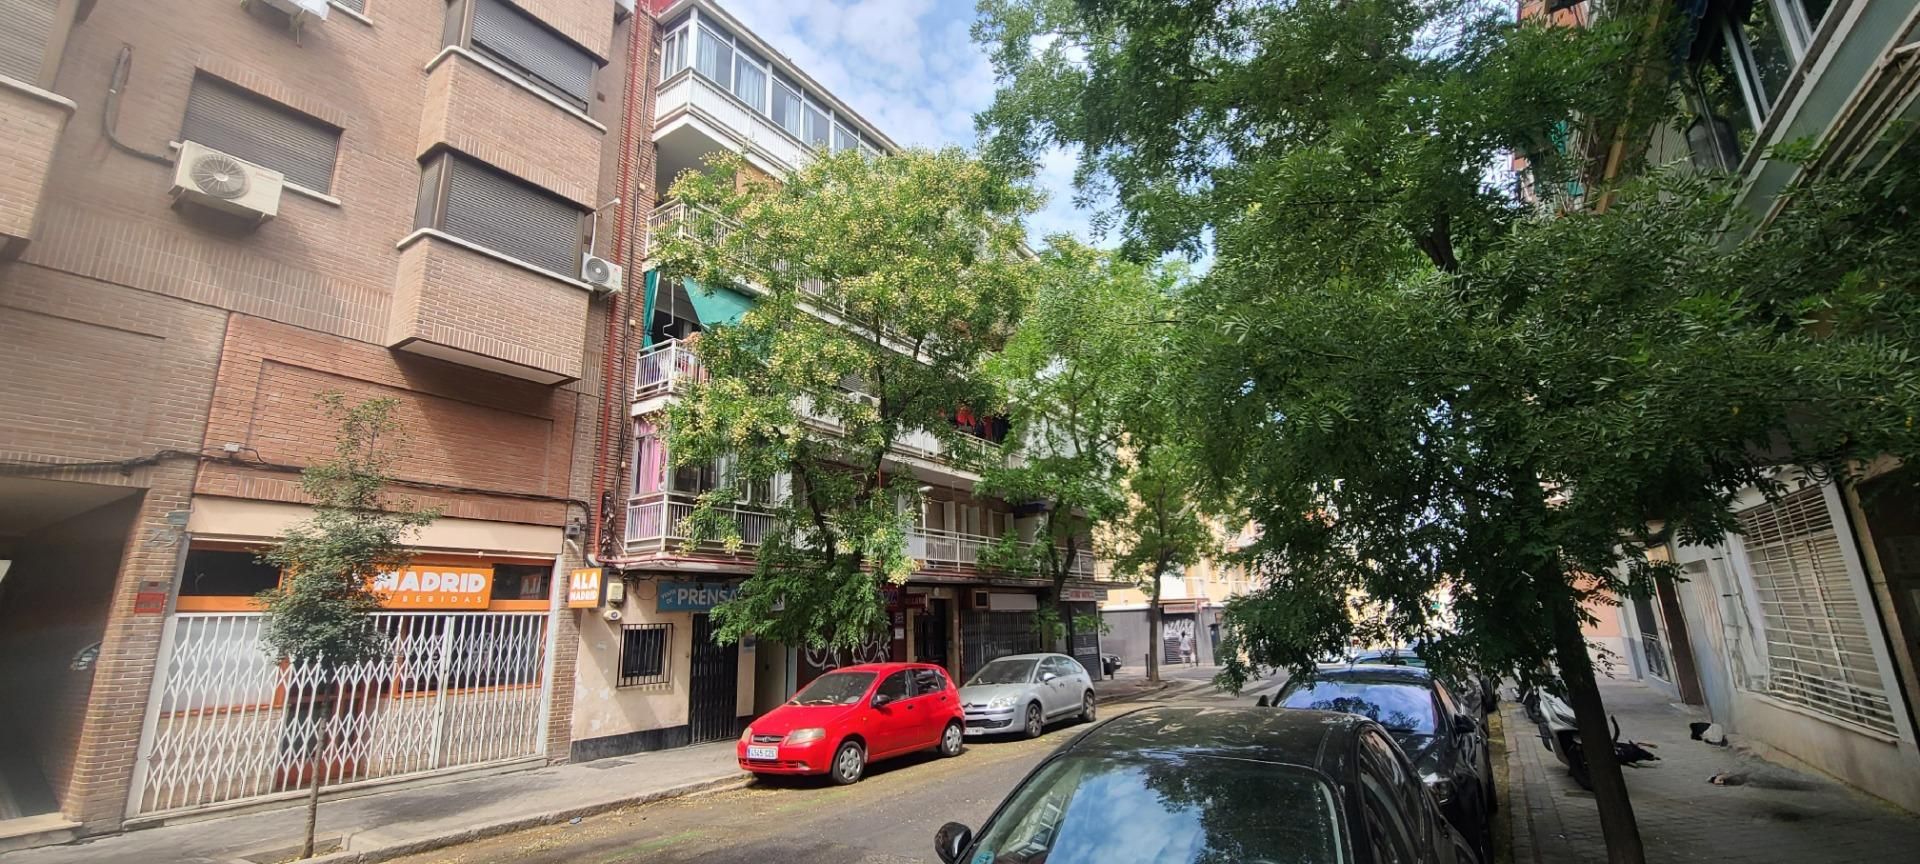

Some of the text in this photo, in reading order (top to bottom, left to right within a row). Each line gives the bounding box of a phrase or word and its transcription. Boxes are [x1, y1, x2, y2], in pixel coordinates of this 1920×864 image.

[373, 570, 486, 593] MADRID
[572, 572, 598, 590] ALA
[402, 595, 482, 604] BEBIDAS
[570, 590, 596, 601] MADRID
[677, 588, 738, 606] PRENSA
